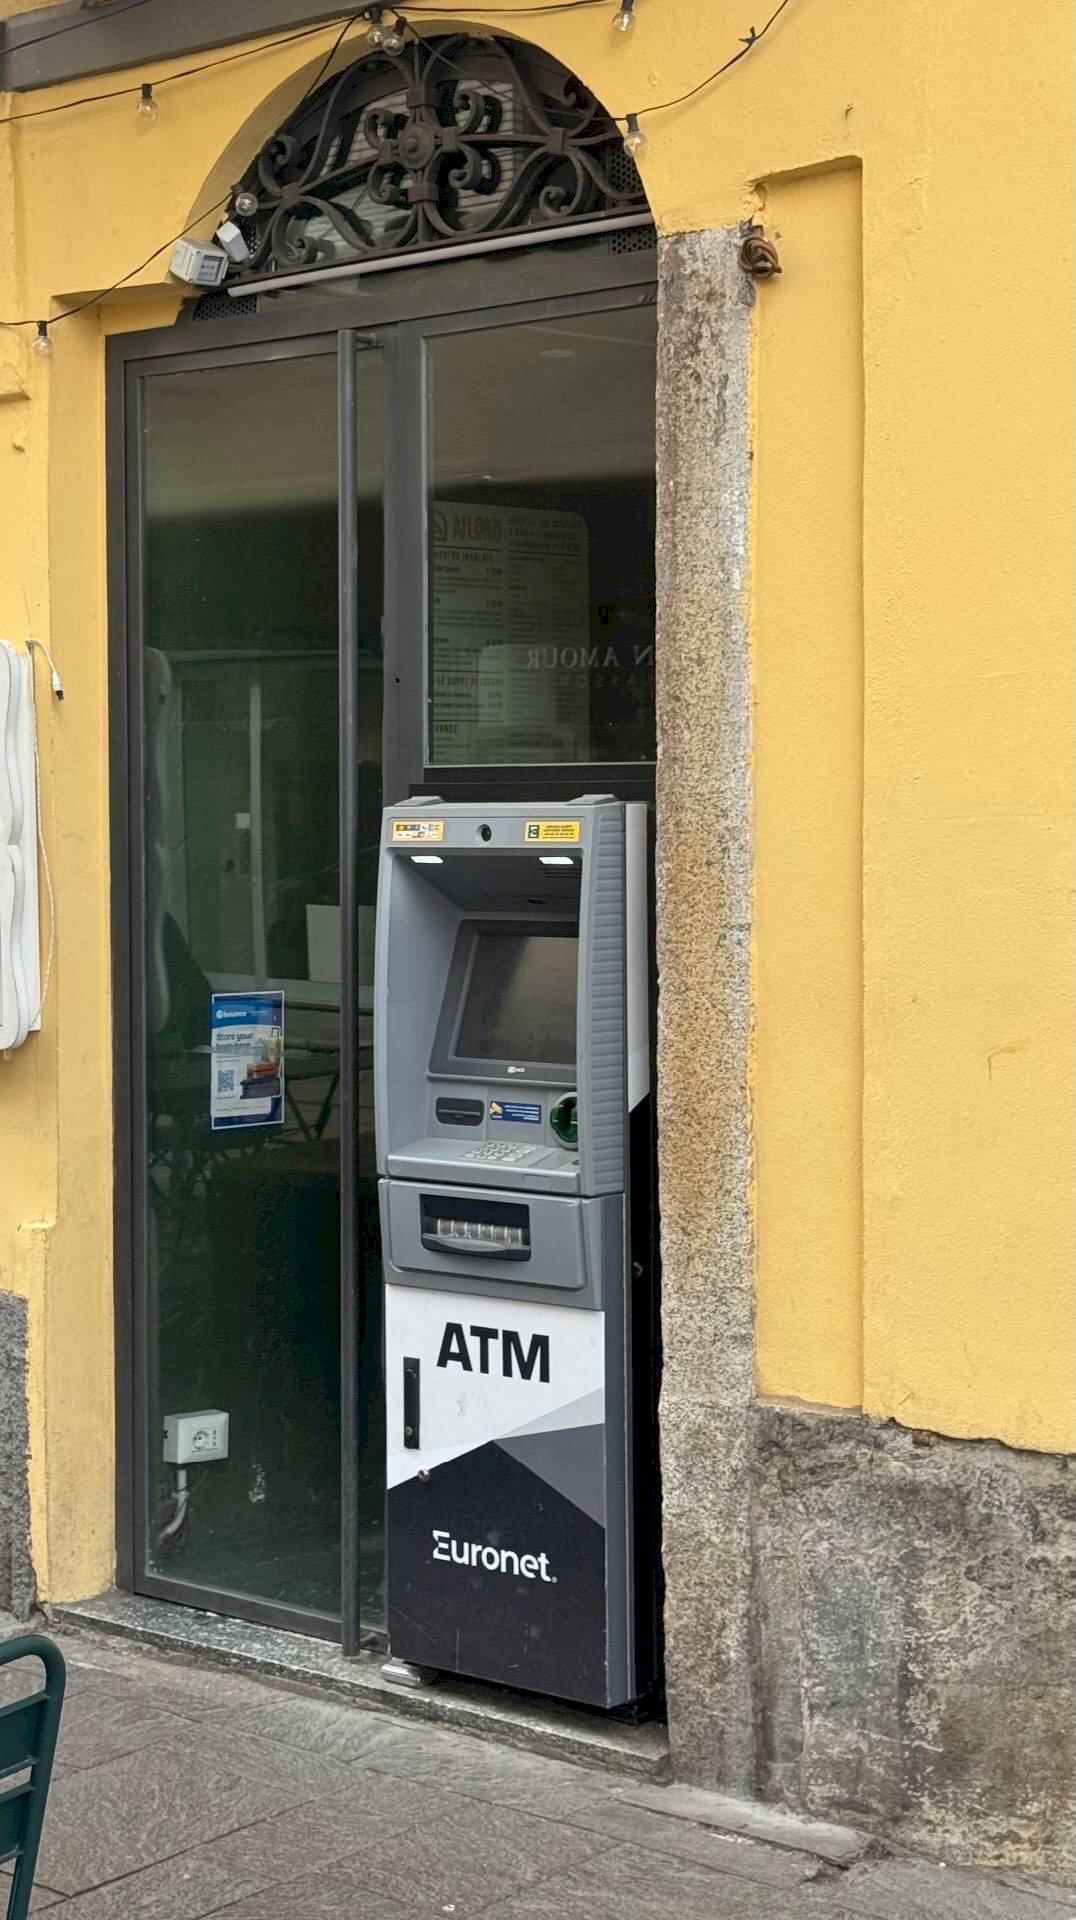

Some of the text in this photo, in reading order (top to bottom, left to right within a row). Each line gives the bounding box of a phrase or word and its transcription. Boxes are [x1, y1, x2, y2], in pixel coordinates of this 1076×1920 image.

[216, 1032, 254, 1042] Store your
[436, 1321, 550, 1383] ATM
